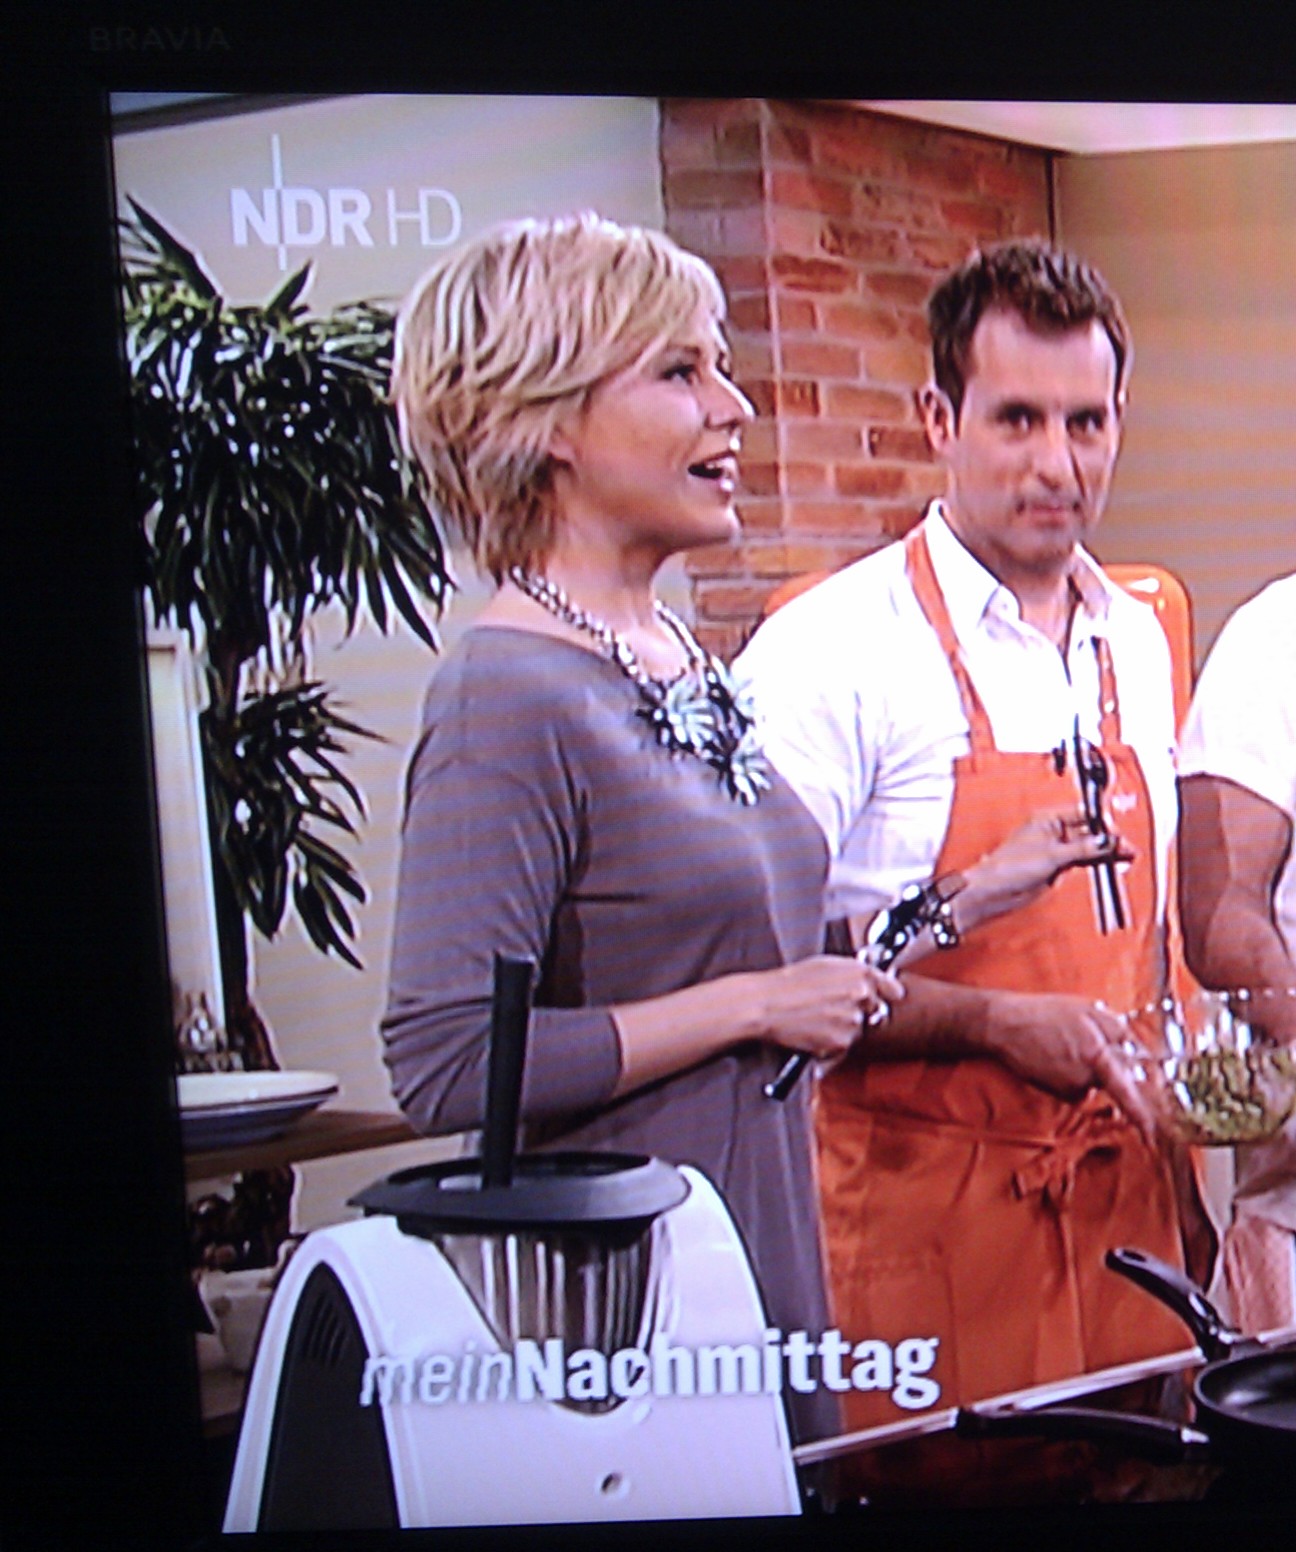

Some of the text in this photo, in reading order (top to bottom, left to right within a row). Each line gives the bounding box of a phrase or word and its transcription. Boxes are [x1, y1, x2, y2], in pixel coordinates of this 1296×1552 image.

[91, 27, 230, 52] BRAVIA
[230, 187, 463, 248] NDR HD
